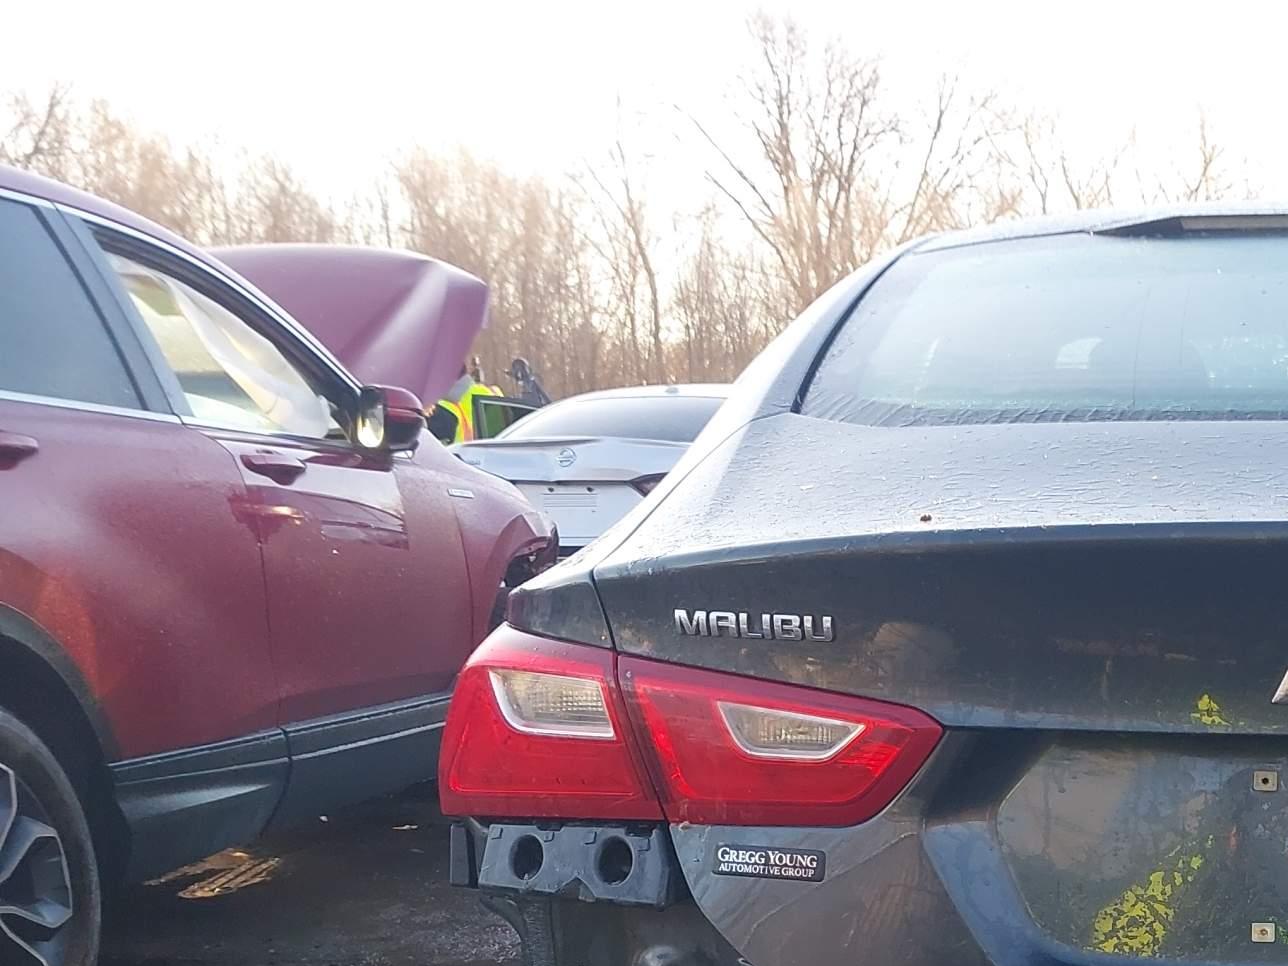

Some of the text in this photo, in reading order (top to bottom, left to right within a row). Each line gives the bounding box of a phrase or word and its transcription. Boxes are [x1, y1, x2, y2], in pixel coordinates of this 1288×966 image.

[673, 607, 834, 642] MALIBU
[717, 847, 818, 868] GREGG YOUNG
[719, 862, 815, 878] AUTOMOTIVE GROUP
